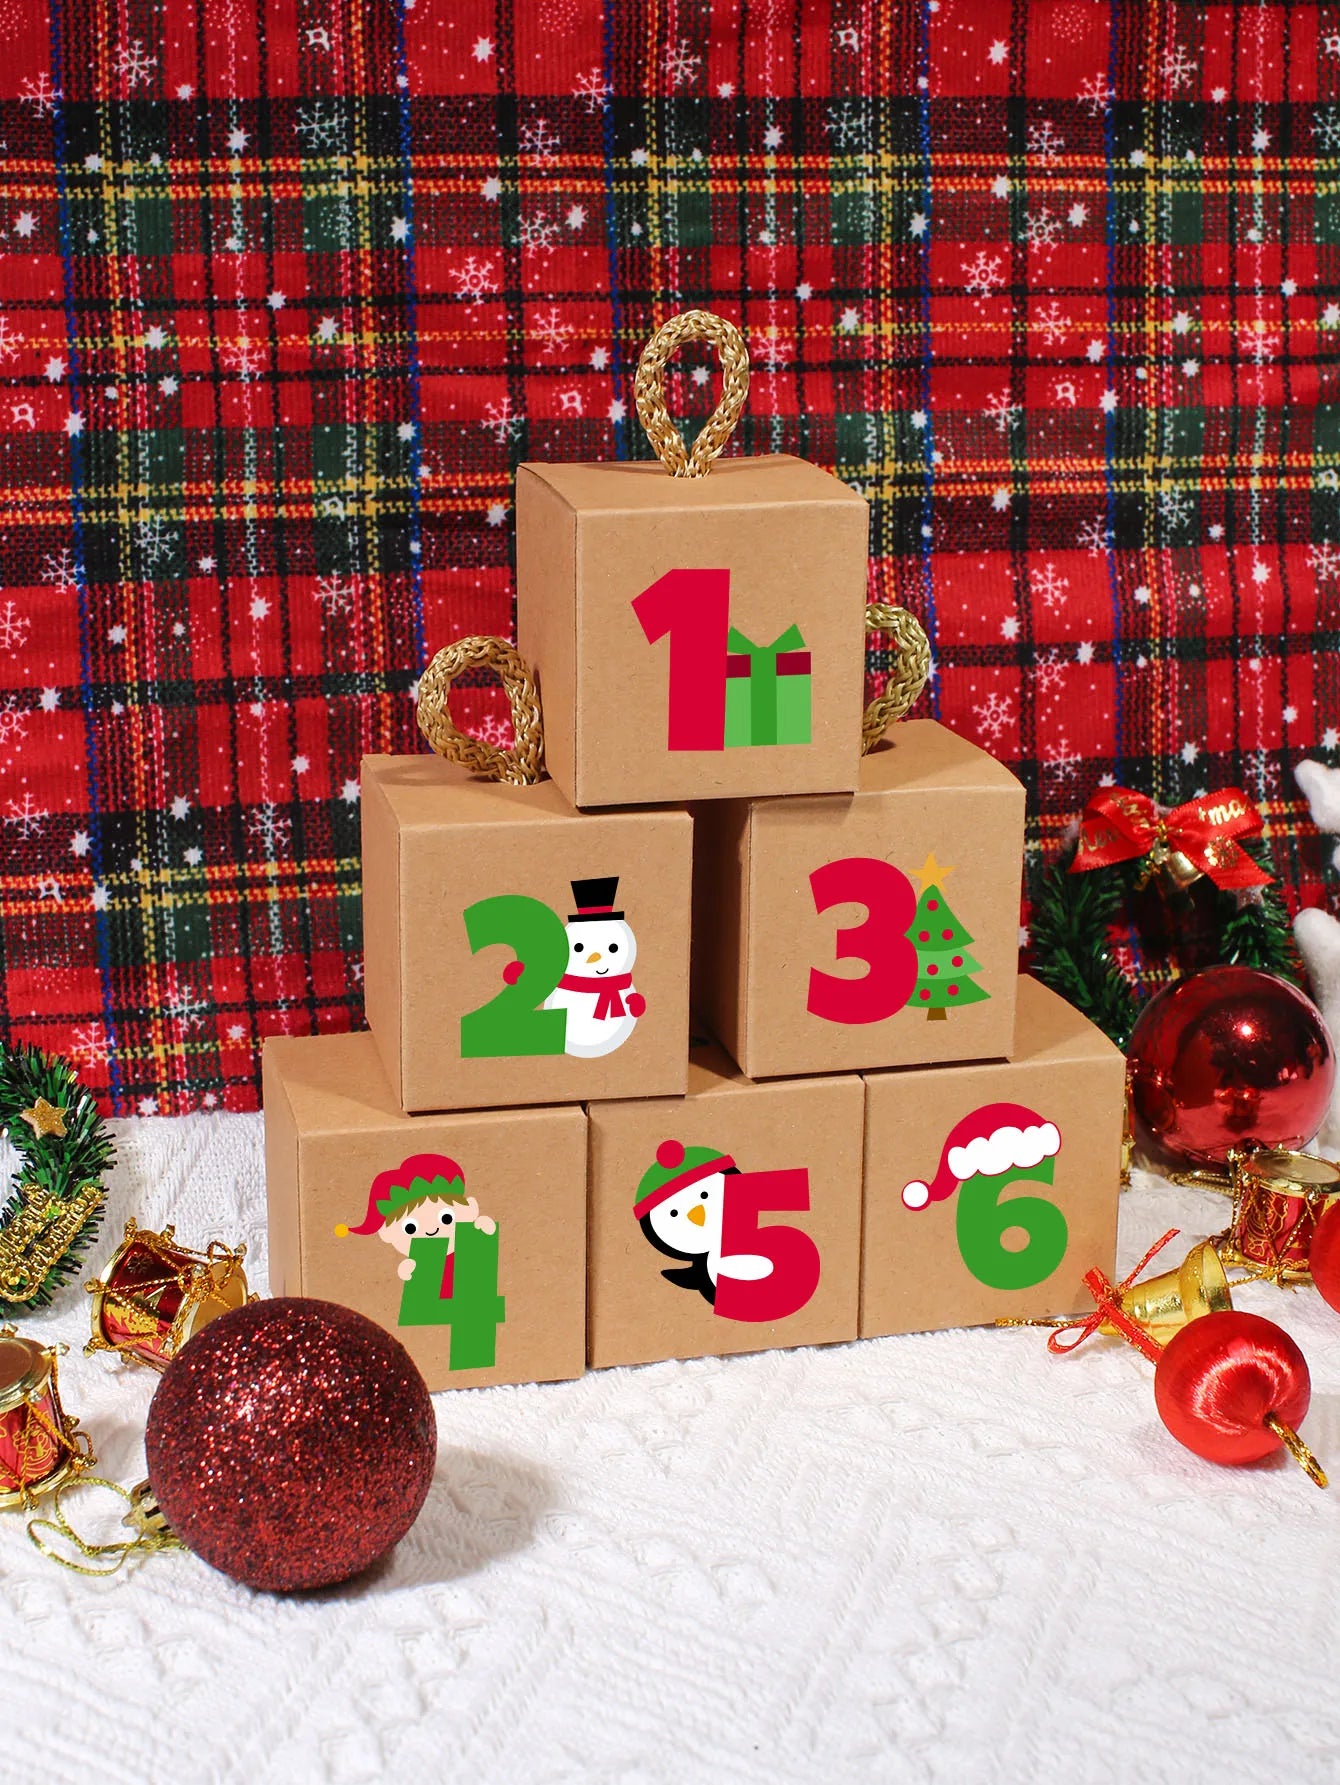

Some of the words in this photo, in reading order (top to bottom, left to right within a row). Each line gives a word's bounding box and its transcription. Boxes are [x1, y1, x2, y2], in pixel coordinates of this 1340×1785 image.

[631, 569, 730, 751] 1
[461, 895, 570, 1058] 2
[807, 857, 918, 1025] 3
[398, 1221, 505, 1371] 4
[713, 1167, 821, 1323] 5
[956, 1156, 1068, 1290] 6
